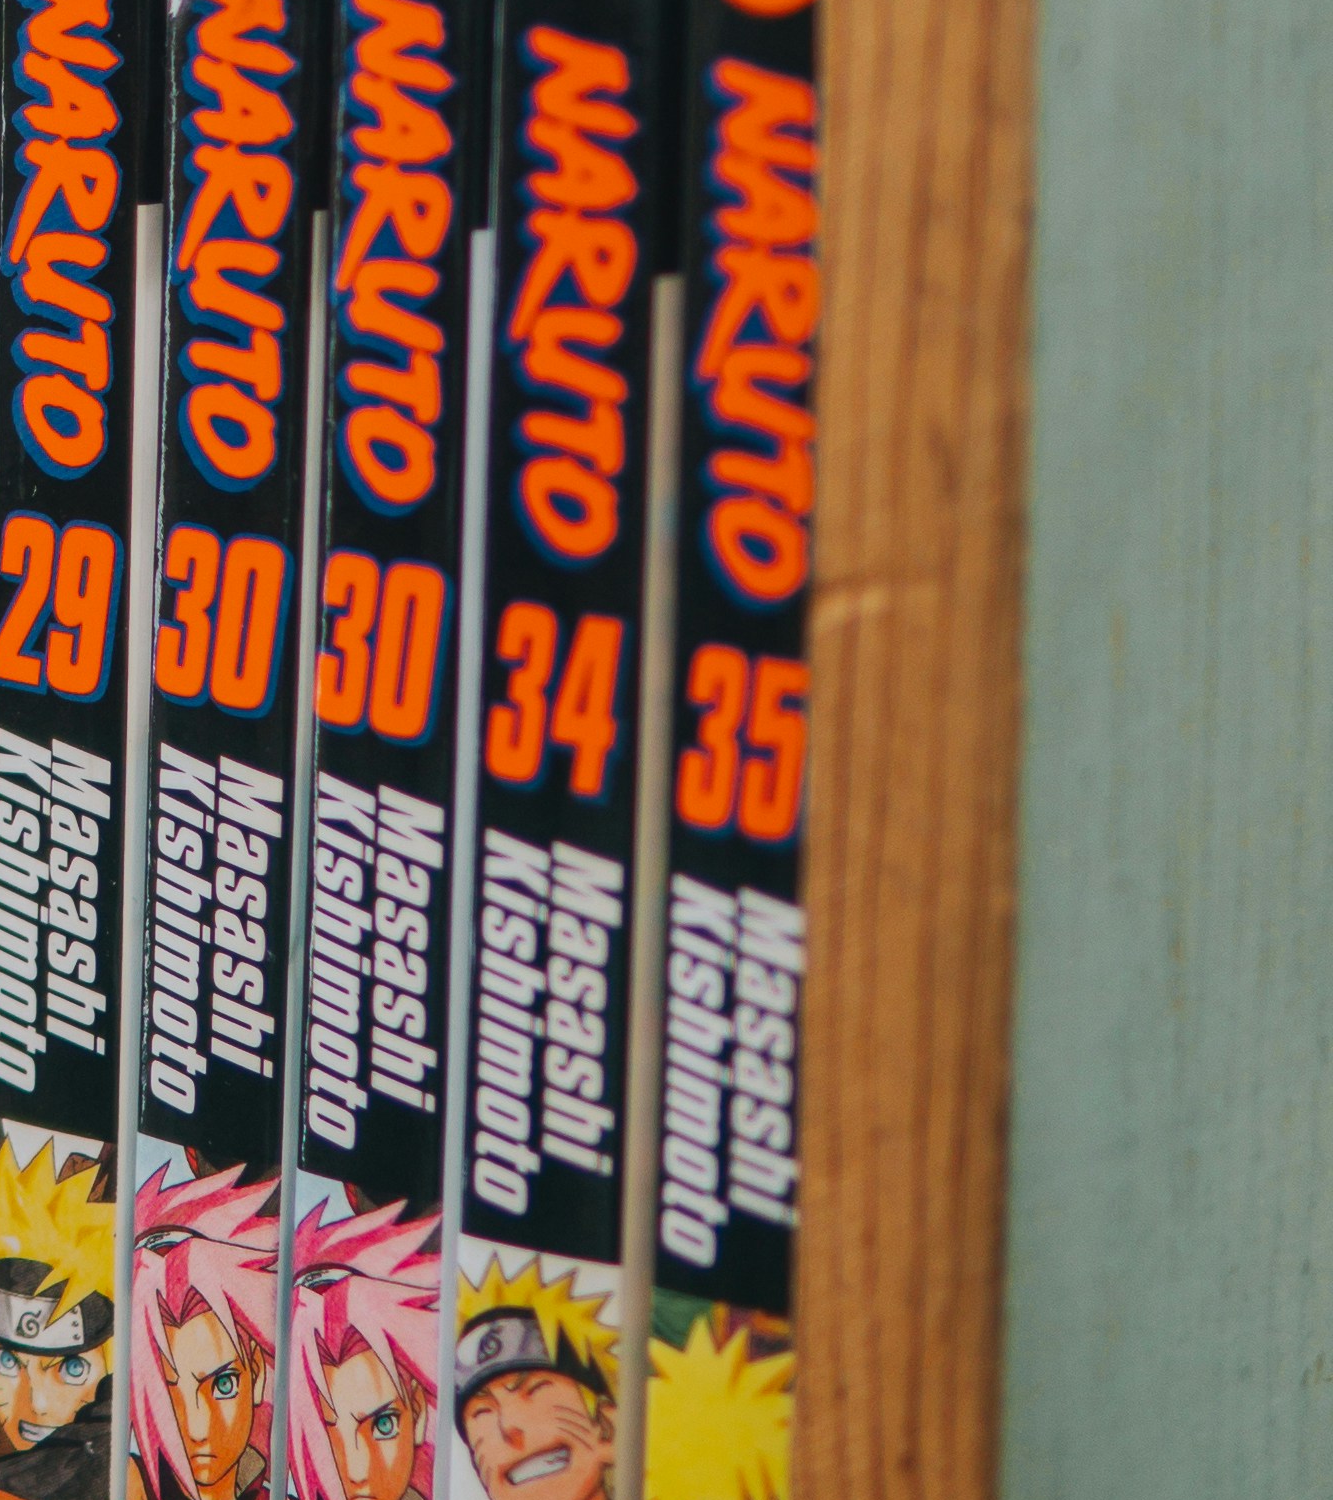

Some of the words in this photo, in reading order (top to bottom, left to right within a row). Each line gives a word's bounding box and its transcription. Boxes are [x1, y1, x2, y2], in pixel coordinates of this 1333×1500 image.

[509, 23, 641, 567] NARUTO
[693, 56, 820, 606] NARUTO
[152, 521, 293, 718] 30
[312, 549, 448, 745] 30
[484, 600, 630, 802] 34
[676, 640, 813, 846] 35
[46, 738, 112, 1056] Masashi
[149, 741, 218, 1115] Kishimoto
[209, 754, 284, 1079] Masashi
[307, 769, 377, 1151] Kishimoto
[370, 783, 446, 1114] Masashi
[472, 828, 551, 1216] Kishimoto
[540, 840, 626, 1178] Masashi
[728, 884, 806, 1229] Masashi
[658, 871, 739, 1269] Kishimoto
